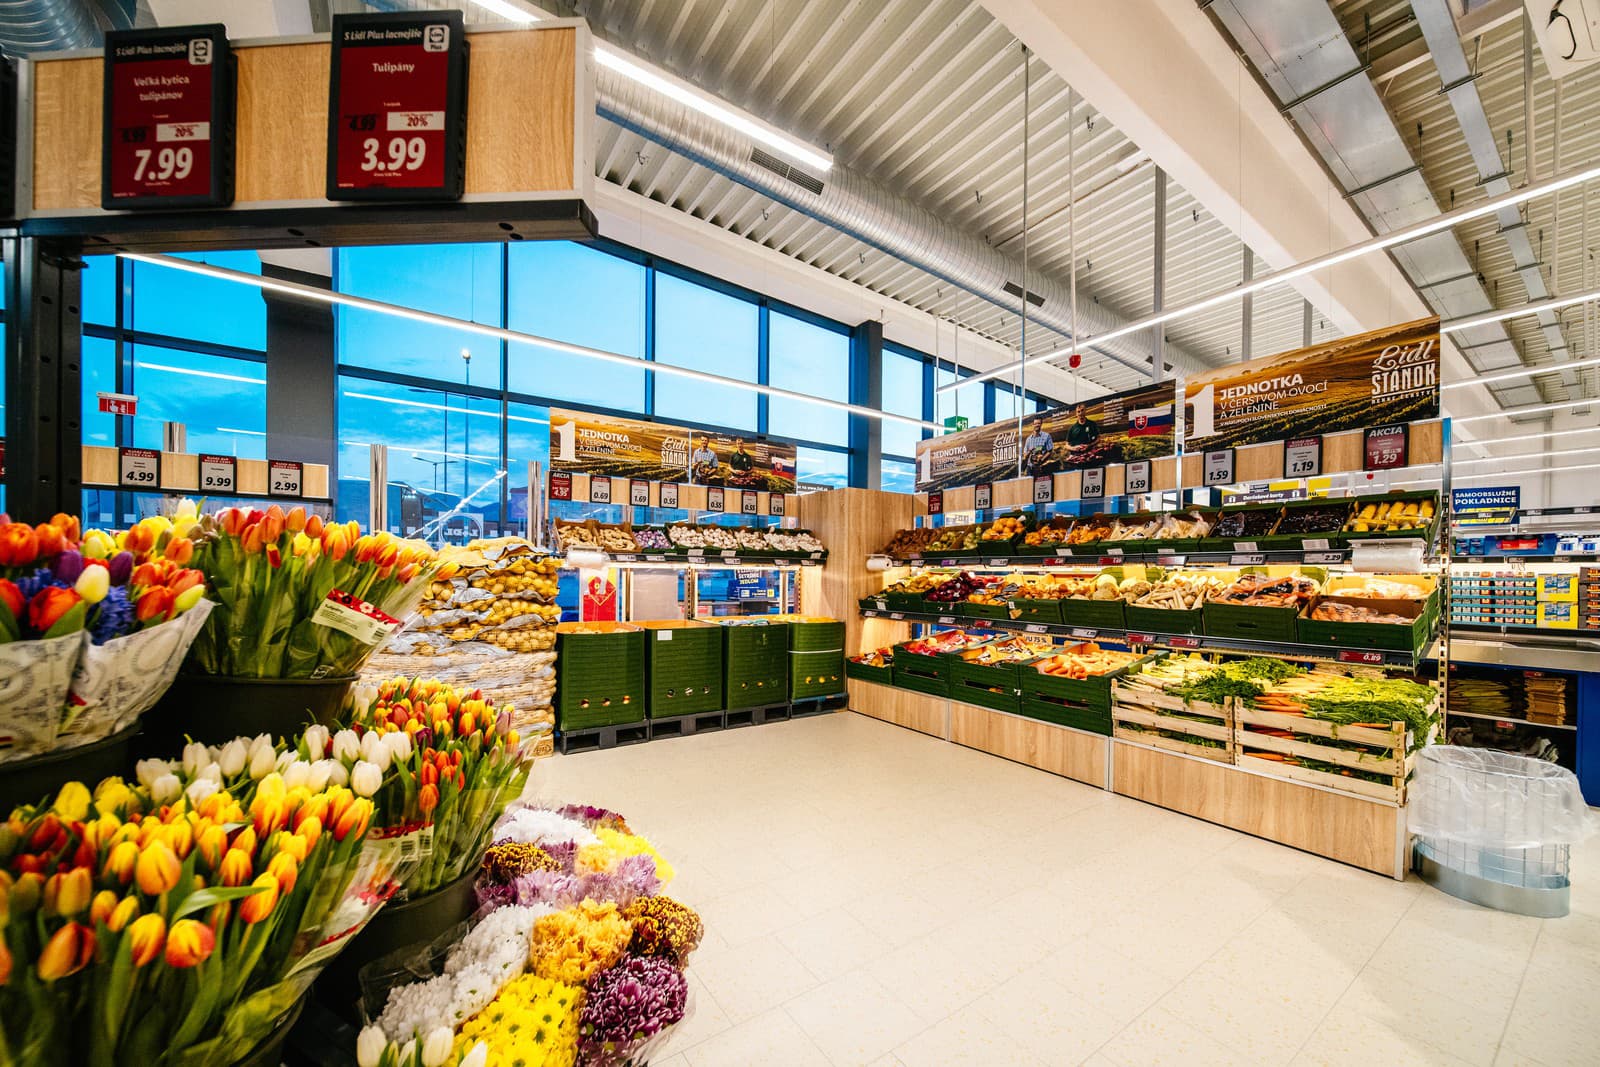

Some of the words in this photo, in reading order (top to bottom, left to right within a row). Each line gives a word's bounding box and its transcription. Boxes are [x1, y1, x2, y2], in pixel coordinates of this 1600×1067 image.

[351, 30, 366, 40] Lidl
[367, 30, 384, 40] Plus
[430, 44, 442, 52] Plus
[372, 63, 415, 74] Tulipány
[134, 78, 160, 87] Veľká
[161, 75, 190, 87] kytica
[139, 91, 184, 102] tulipánov
[407, 117, 429, 127] 20%
[175, 128, 194, 137] 20%
[361, 138, 426, 171] 3.99
[133, 148, 193, 181] 7.99
[1373, 340, 1435, 371] Lidl
[1219, 374, 1303, 401] JEDNOTKA
[1220, 402, 1227, 410] V
[1228, 391, 1287, 408] ČERSTVOM
[1287, 381, 1328, 398] OVOCÍ
[1185, 384, 1224, 441] 1
[1219, 412, 1228, 420] A
[1228, 402, 1279, 418] ZELENINE
[579, 429, 630, 443] JEDNOTKA
[1369, 426, 1403, 438] AKCIA
[553, 421, 582, 462] 1
[662, 437, 687, 450] Lidl
[993, 432, 1017, 448] Lidl
[933, 445, 967, 459] JEDNOTKA
[1373, 454, 1397, 465] 1.29
[917, 448, 934, 484] 1
[1292, 461, 1314, 472] 1.19
[126, 471, 154, 482] 4.99
[1209, 470, 1228, 481] 1.59
[205, 477, 231, 487] 9.99
[274, 481, 298, 491] 2.99
[1129, 480, 1145, 489] 1.59
[1084, 485, 1100, 494] 0.89
[1455, 490, 1517, 499] SAMOOBSLUŽNÉ
[663, 497, 676, 505] 0.55
[1037, 491, 1049, 500] 1.79
[1455, 497, 1517, 506] POKLADNICE
